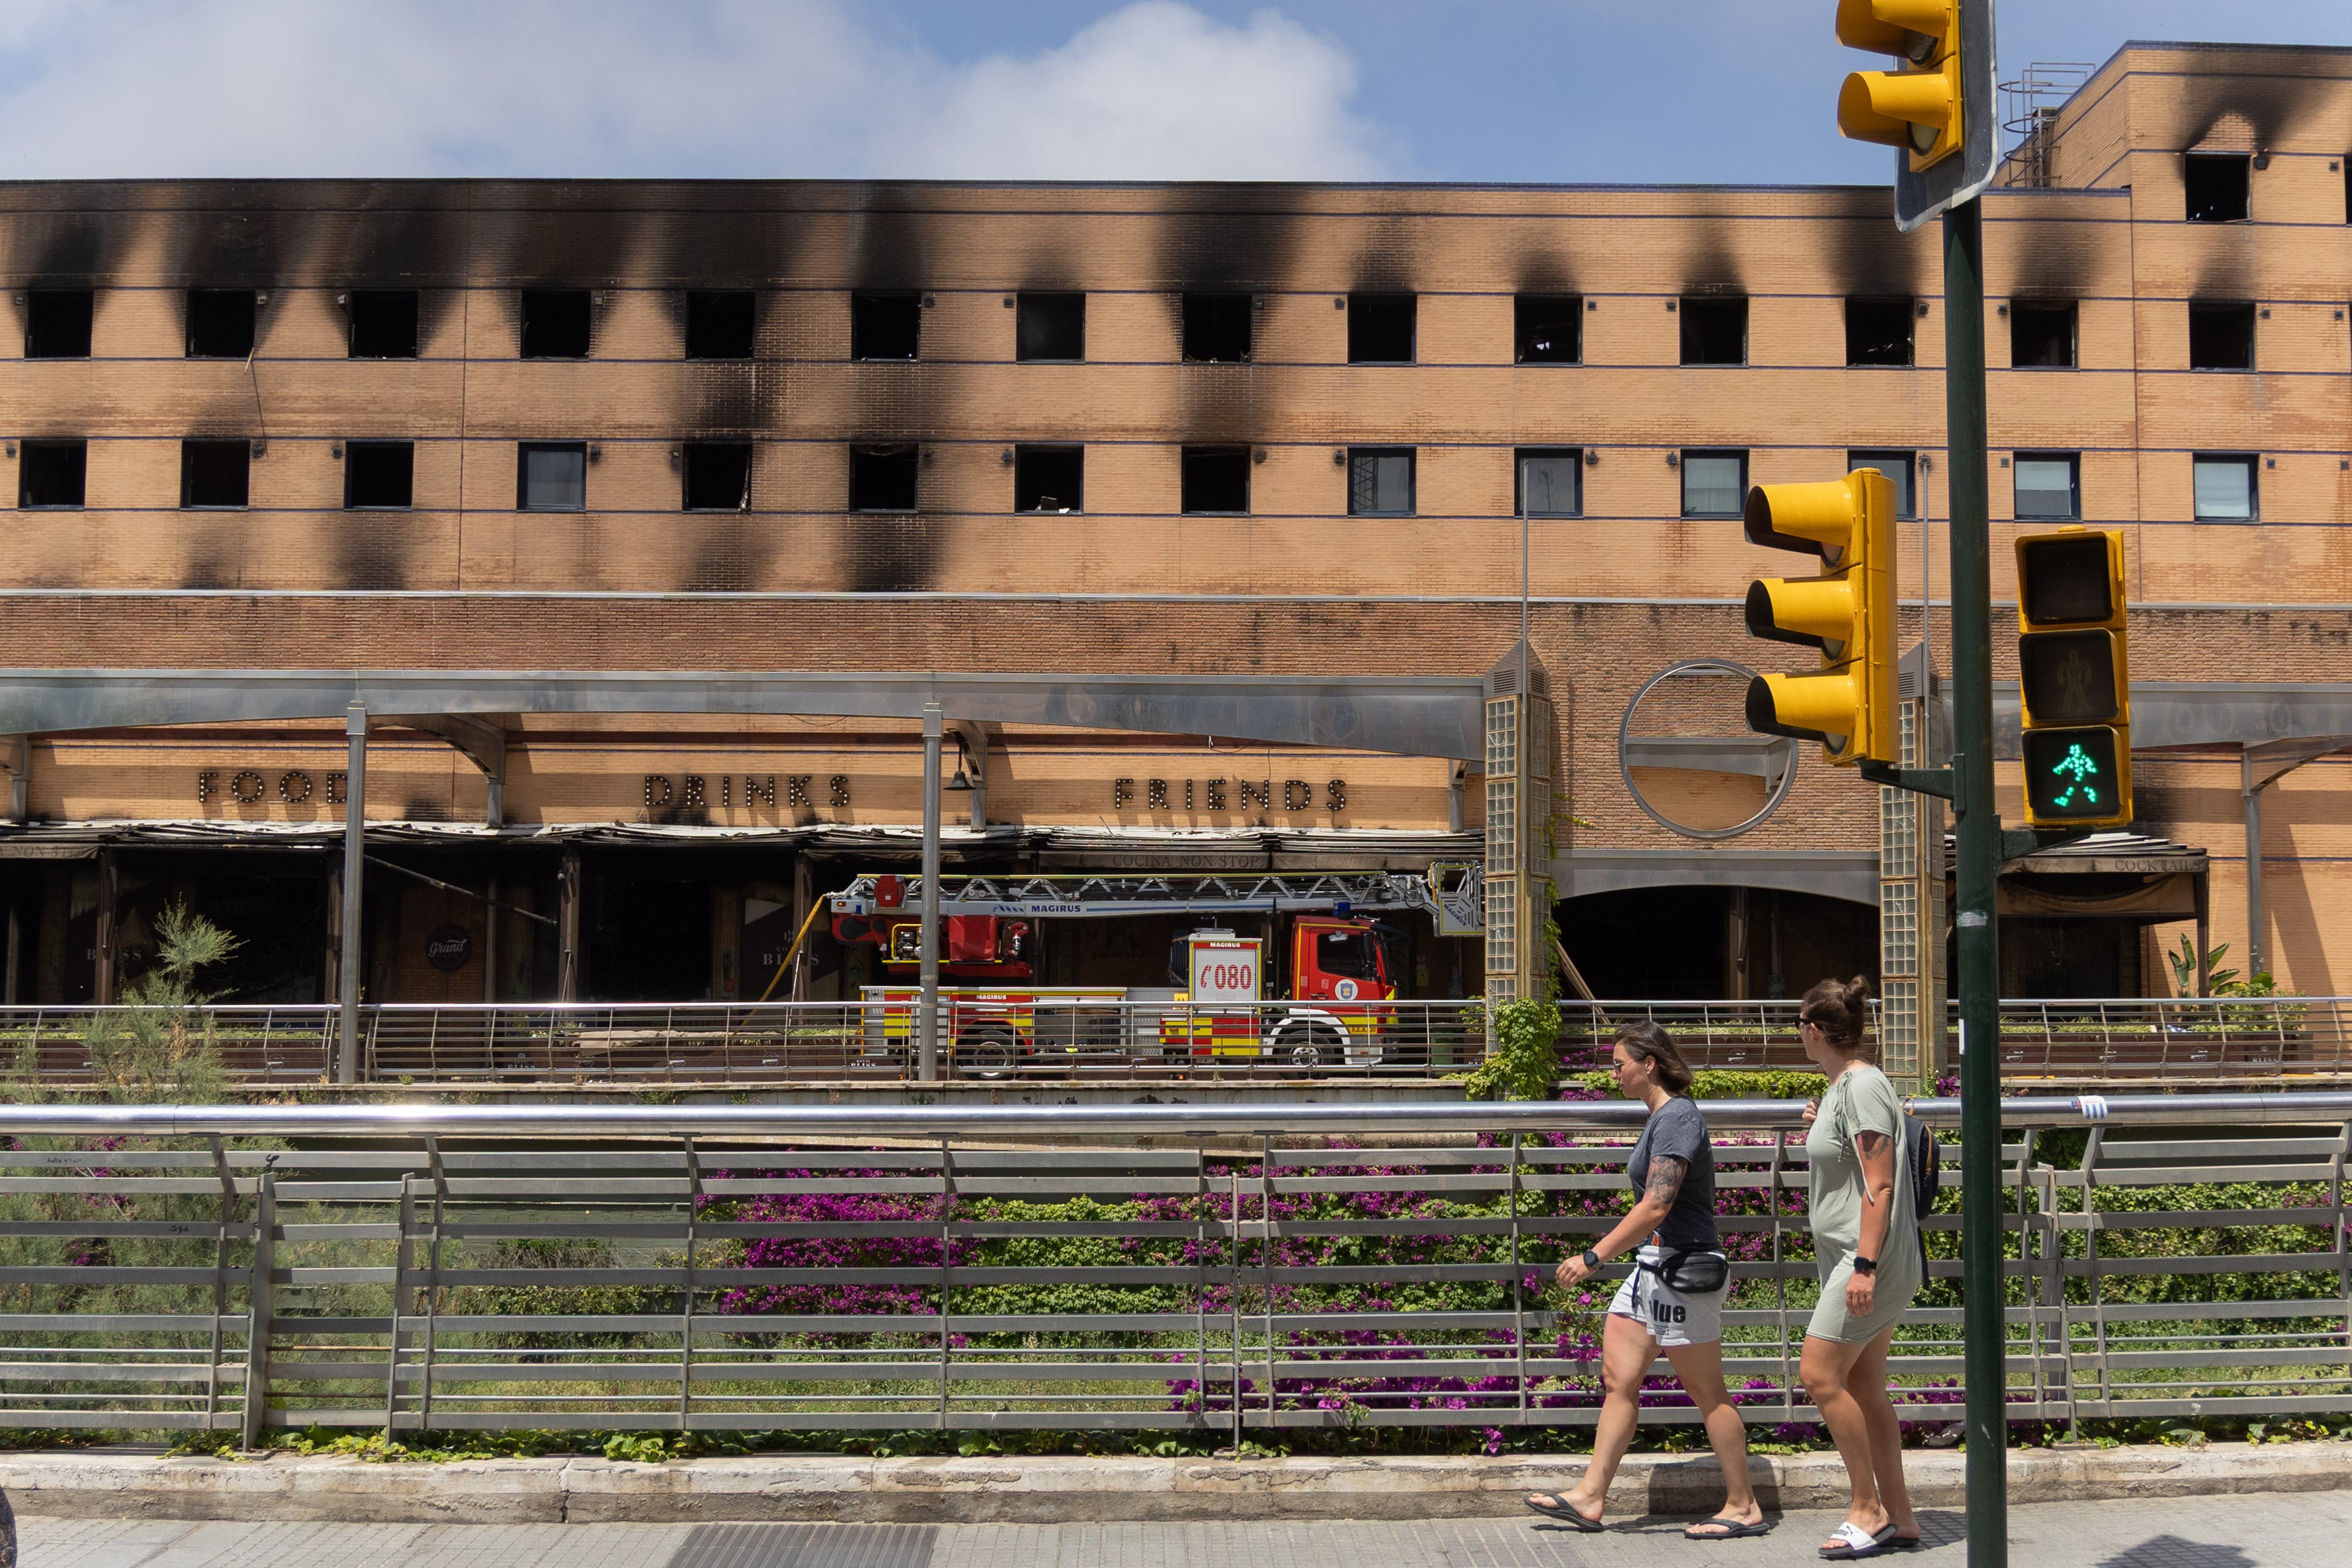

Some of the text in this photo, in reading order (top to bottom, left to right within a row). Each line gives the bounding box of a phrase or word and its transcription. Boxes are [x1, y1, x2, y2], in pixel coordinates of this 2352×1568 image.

[198, 771, 349, 804] FOOD
[645, 775, 851, 808] DRINKS
[1115, 778, 1347, 811] FRIENDS
[1113, 854, 1260, 868] COCINA NON STOP
[2115, 859, 2201, 872] COCKTAILS
[1443, 903, 1468, 927] MAGIRUS
[428, 938, 467, 957] Grand
[1214, 964, 1252, 990] 080
[1649, 1299, 1686, 1323] lue
